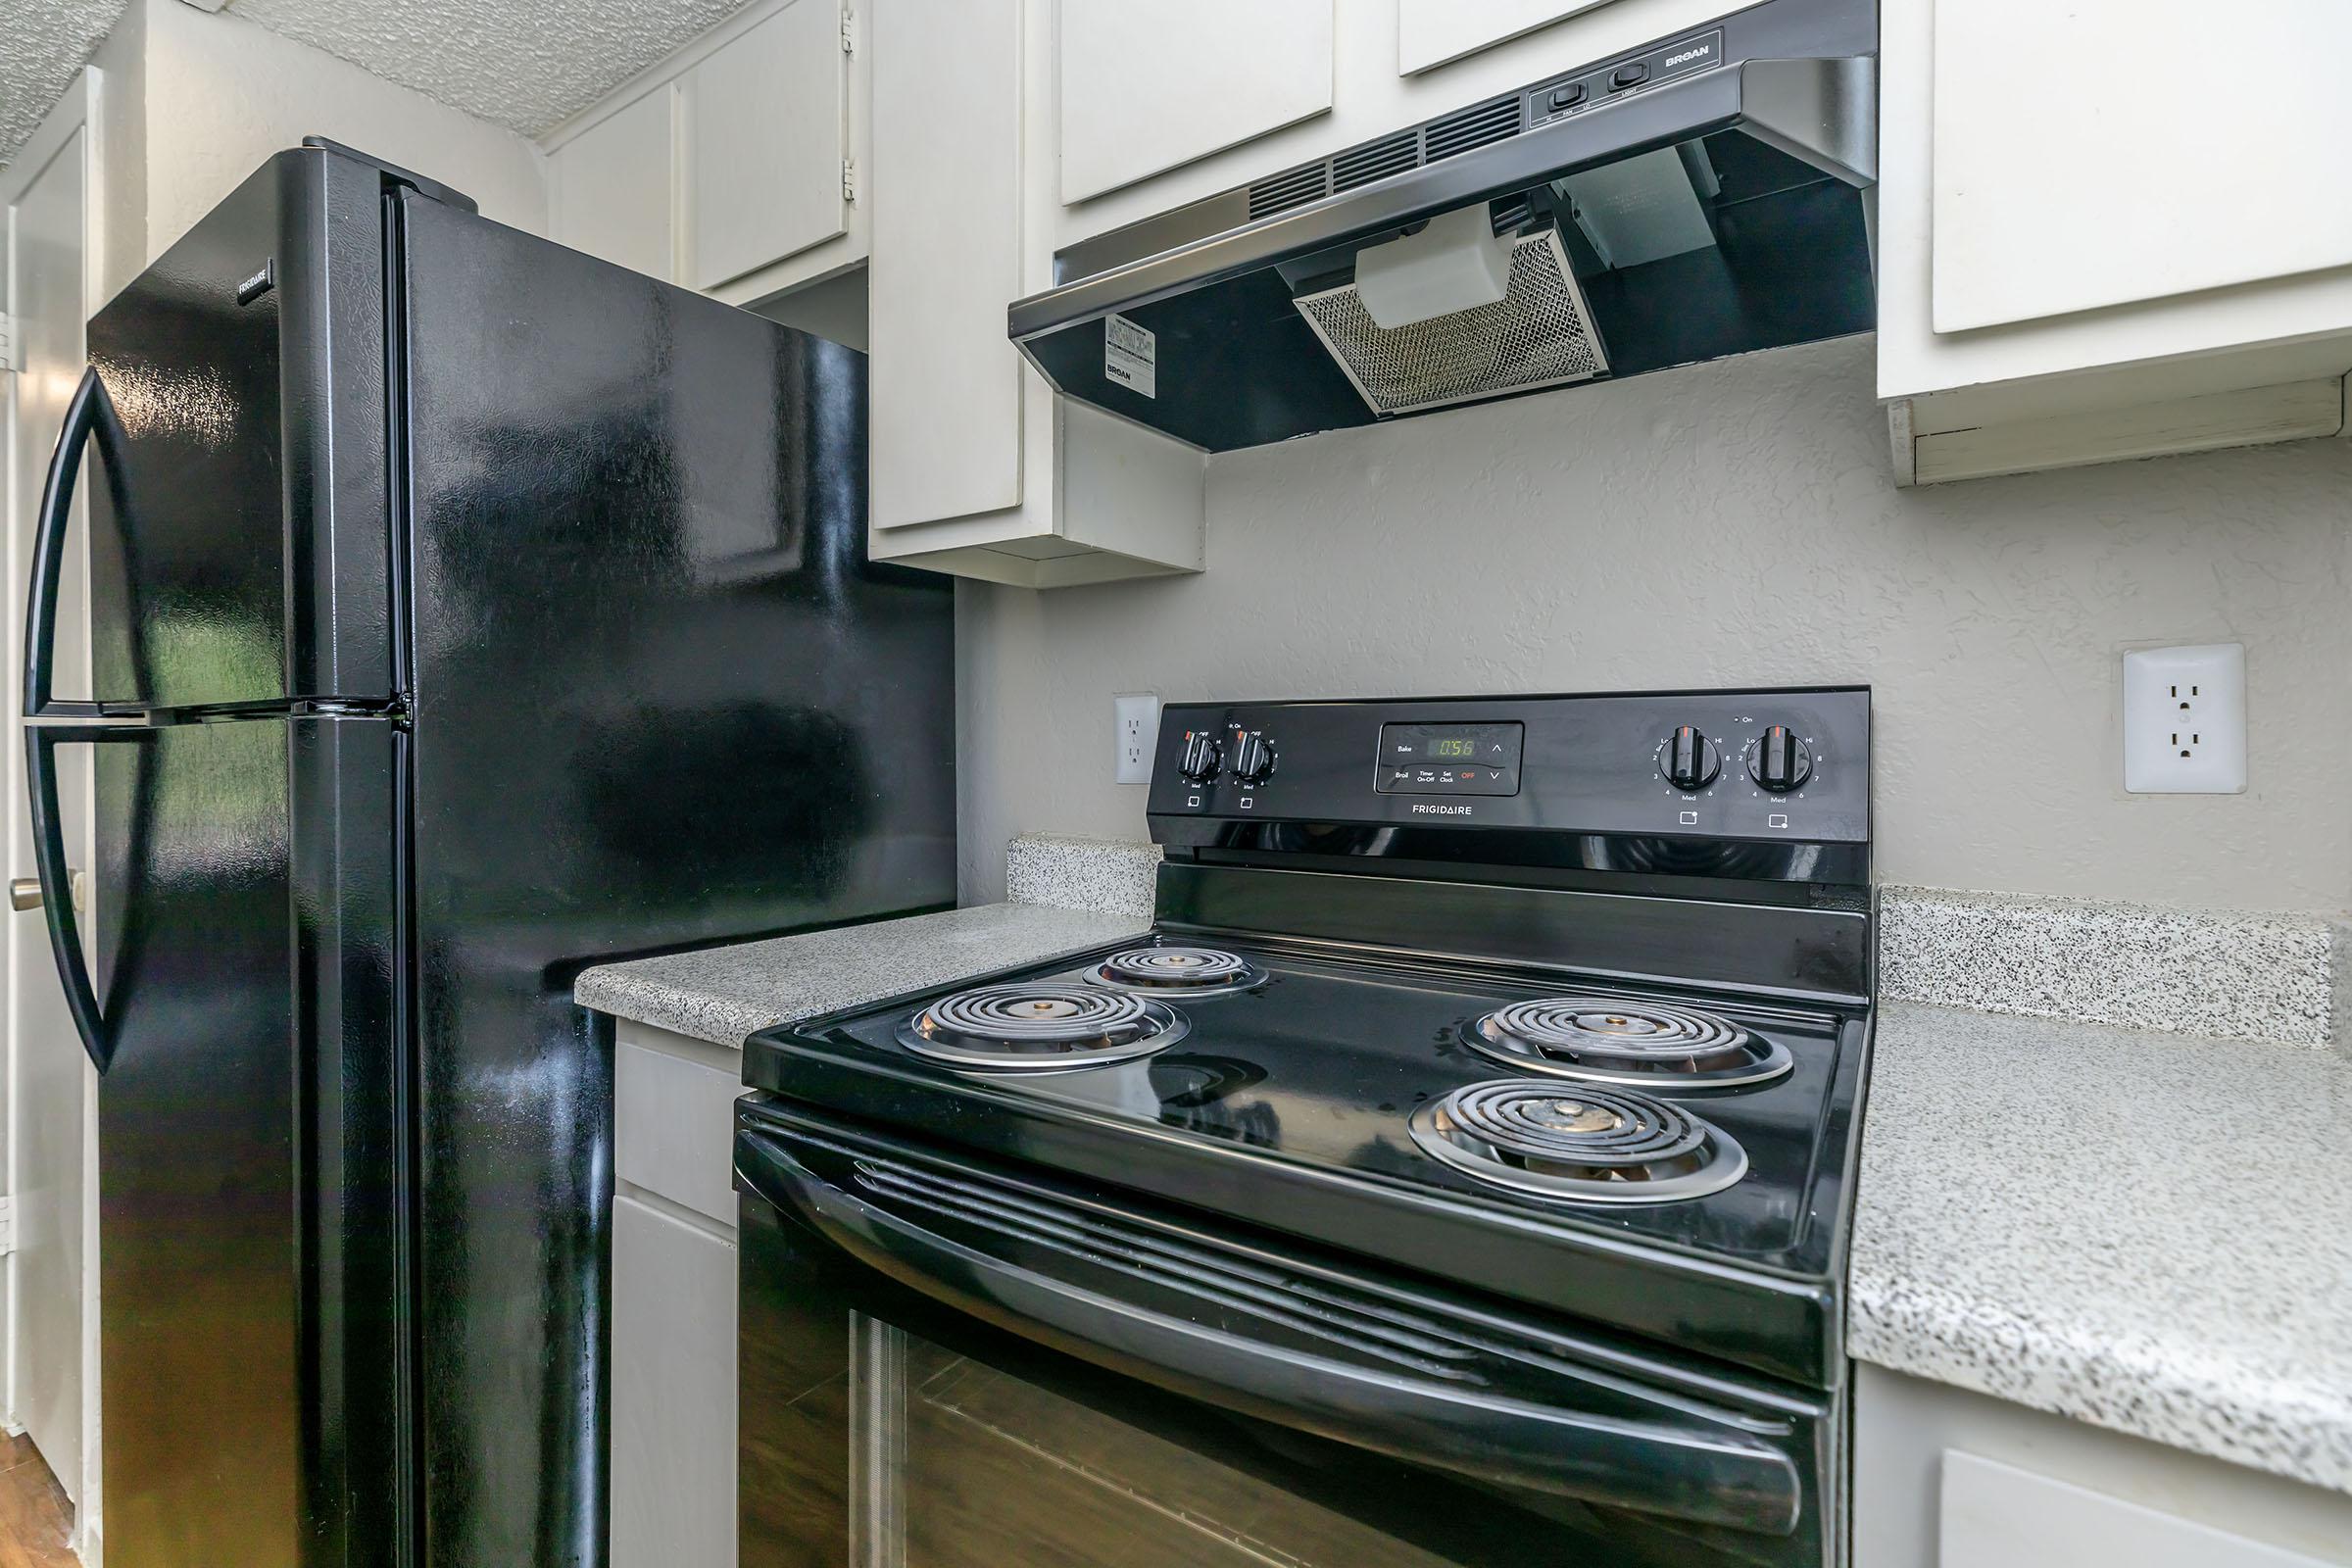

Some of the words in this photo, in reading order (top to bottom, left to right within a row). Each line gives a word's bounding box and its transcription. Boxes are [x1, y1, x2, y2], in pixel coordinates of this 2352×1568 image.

[1665, 45, 1709, 67] BROAN
[1107, 364, 1131, 380] BROAN
[1413, 805, 1472, 815] FRIGIDAIRE
